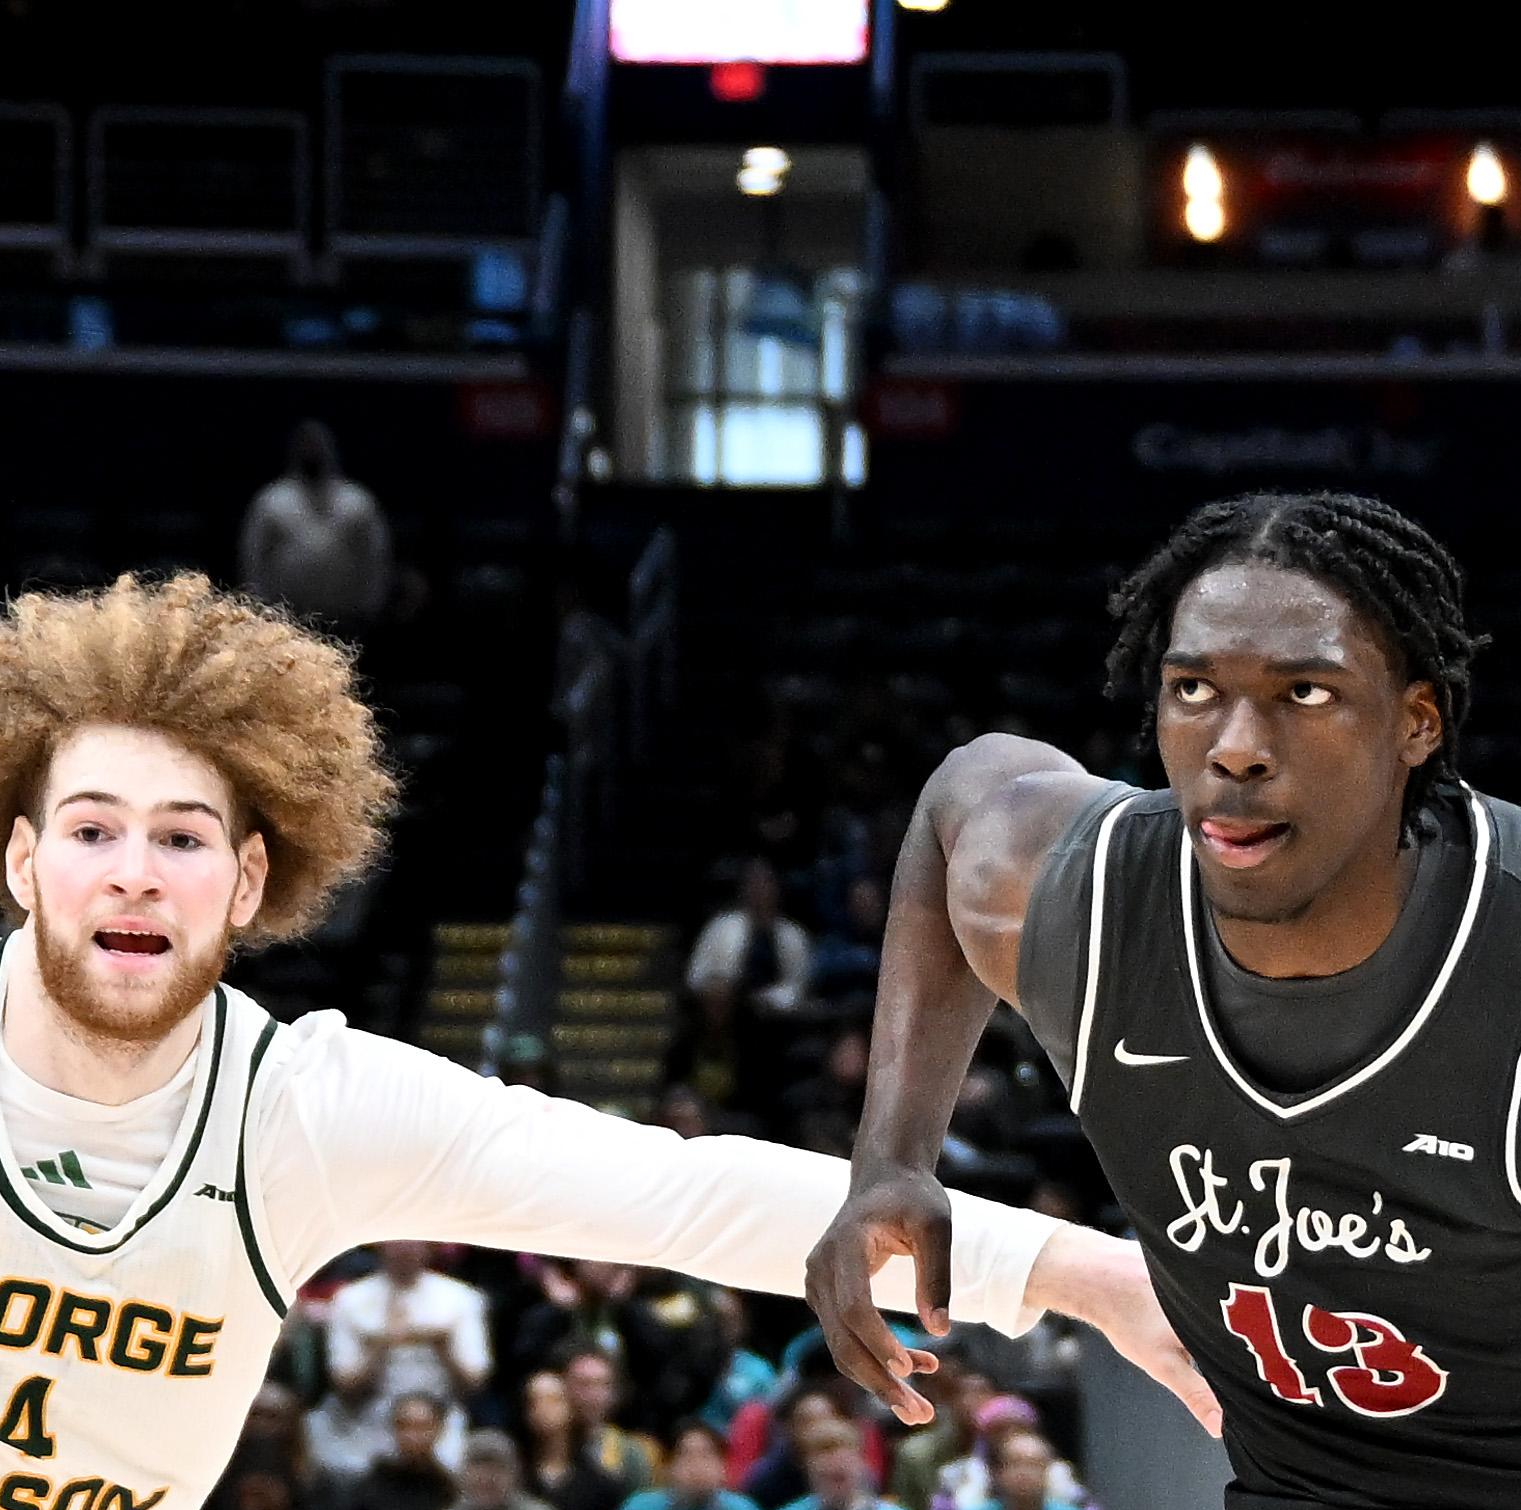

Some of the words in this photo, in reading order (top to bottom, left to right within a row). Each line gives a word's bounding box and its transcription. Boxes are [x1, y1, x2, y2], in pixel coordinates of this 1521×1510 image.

[1166, 1144, 1250, 1252] St.
[1249, 1157, 1432, 1278] Joe's
[1401, 1133, 1474, 1161] A10
[1219, 1282, 1450, 1418] 13
